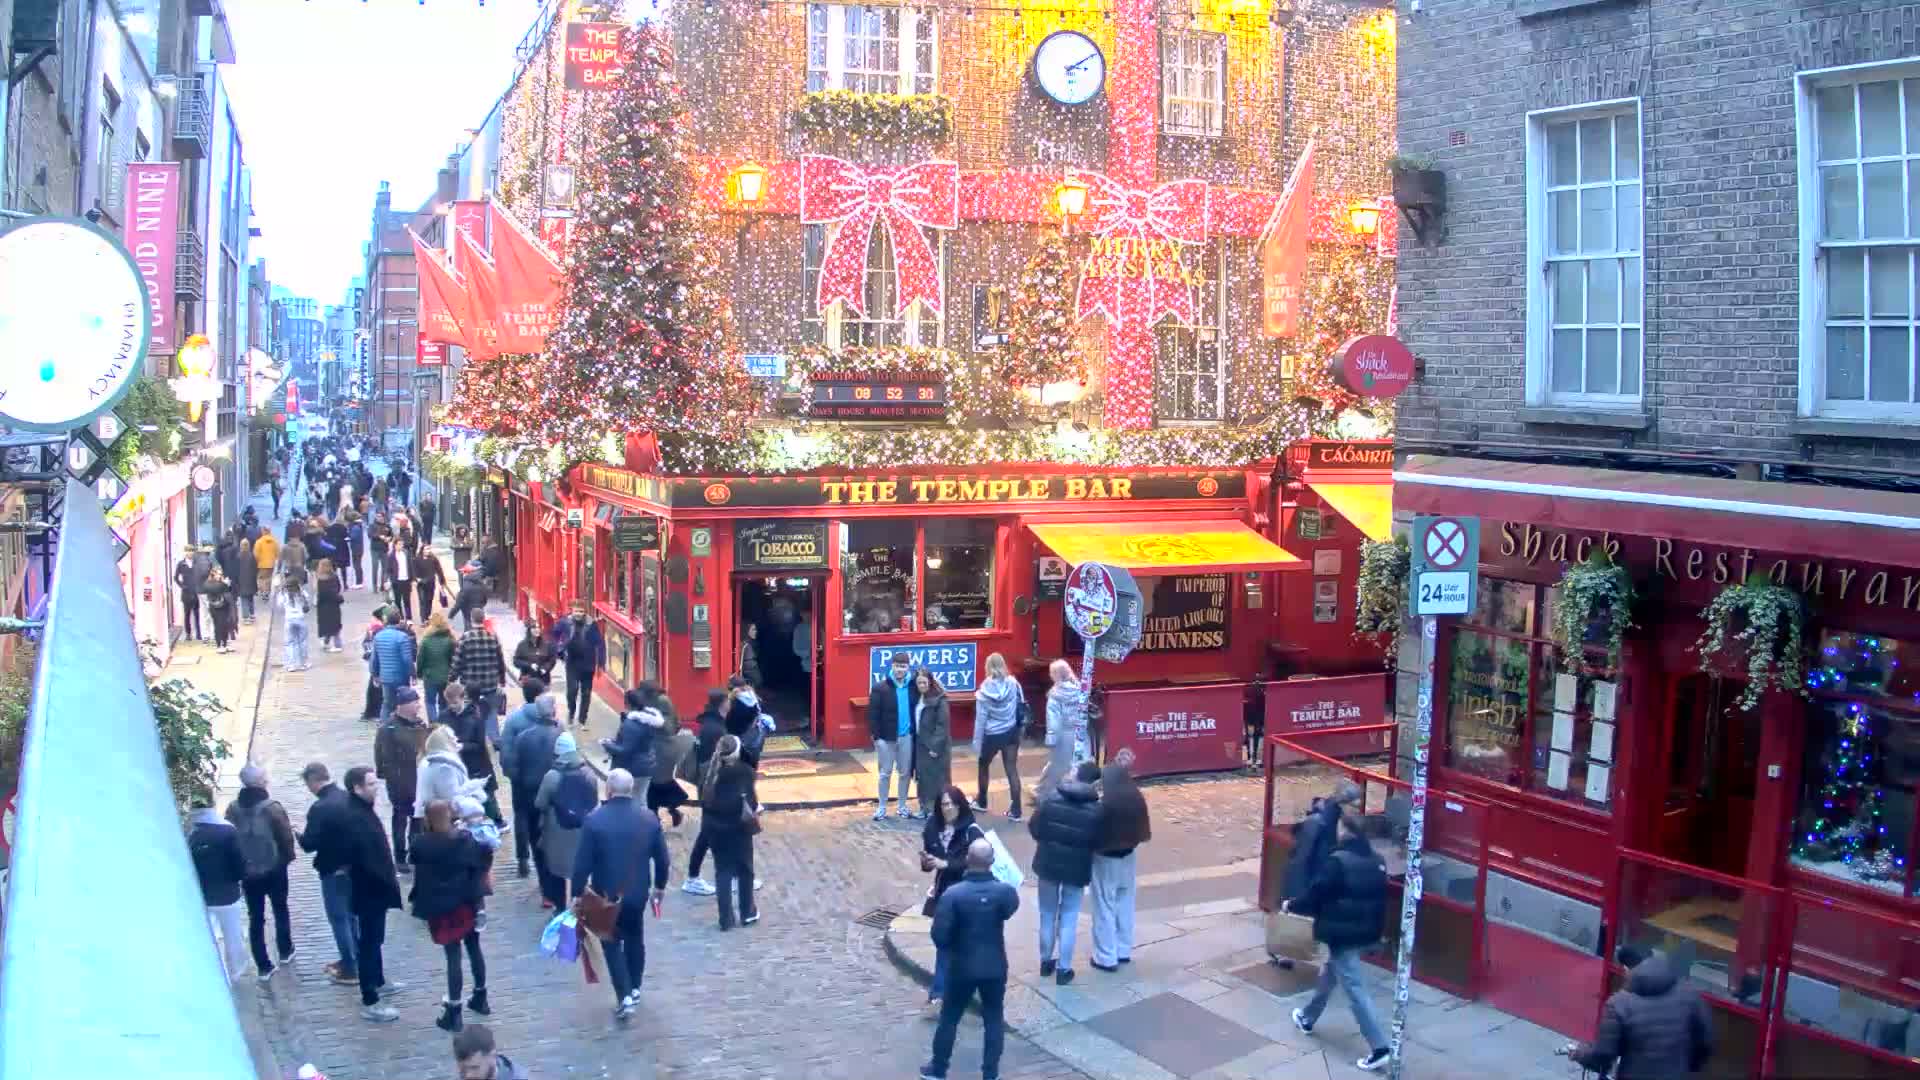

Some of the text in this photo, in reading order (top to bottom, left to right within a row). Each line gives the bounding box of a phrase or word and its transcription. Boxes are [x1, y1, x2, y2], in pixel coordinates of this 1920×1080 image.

[584, 28, 617, 44] THE
[136, 171, 169, 232] NINE
[1088, 236, 1185, 263] MERRY
[522, 303, 545, 313] THE
[503, 312, 556, 325] TEMPL
[519, 325, 550, 337] BAR
[827, 387, 834, 399] 1
[886, 387, 903, 399] 52
[812, 408, 832, 416] DAYS
[838, 408, 864, 416] HOURS
[870, 408, 904, 416] MINUTES
[823, 478, 1133, 503] THE TEMPLE BAR
[1500, 519, 1621, 566] Shack
[873, 553, 889, 562] THE
[1176, 577, 1226, 593] EMPEROR
[1422, 584, 1442, 602] 24
[1212, 592, 1225, 608] OF
[1444, 593, 1465, 602] HOUR
[880, 647, 969, 668] PWER'S
[1318, 701, 1335, 710] THE
[1168, 712, 1187, 721] THE
[1290, 706, 1360, 722] TEMPLE BAR
[1136, 718, 1216, 734] TEMPLE BAR
